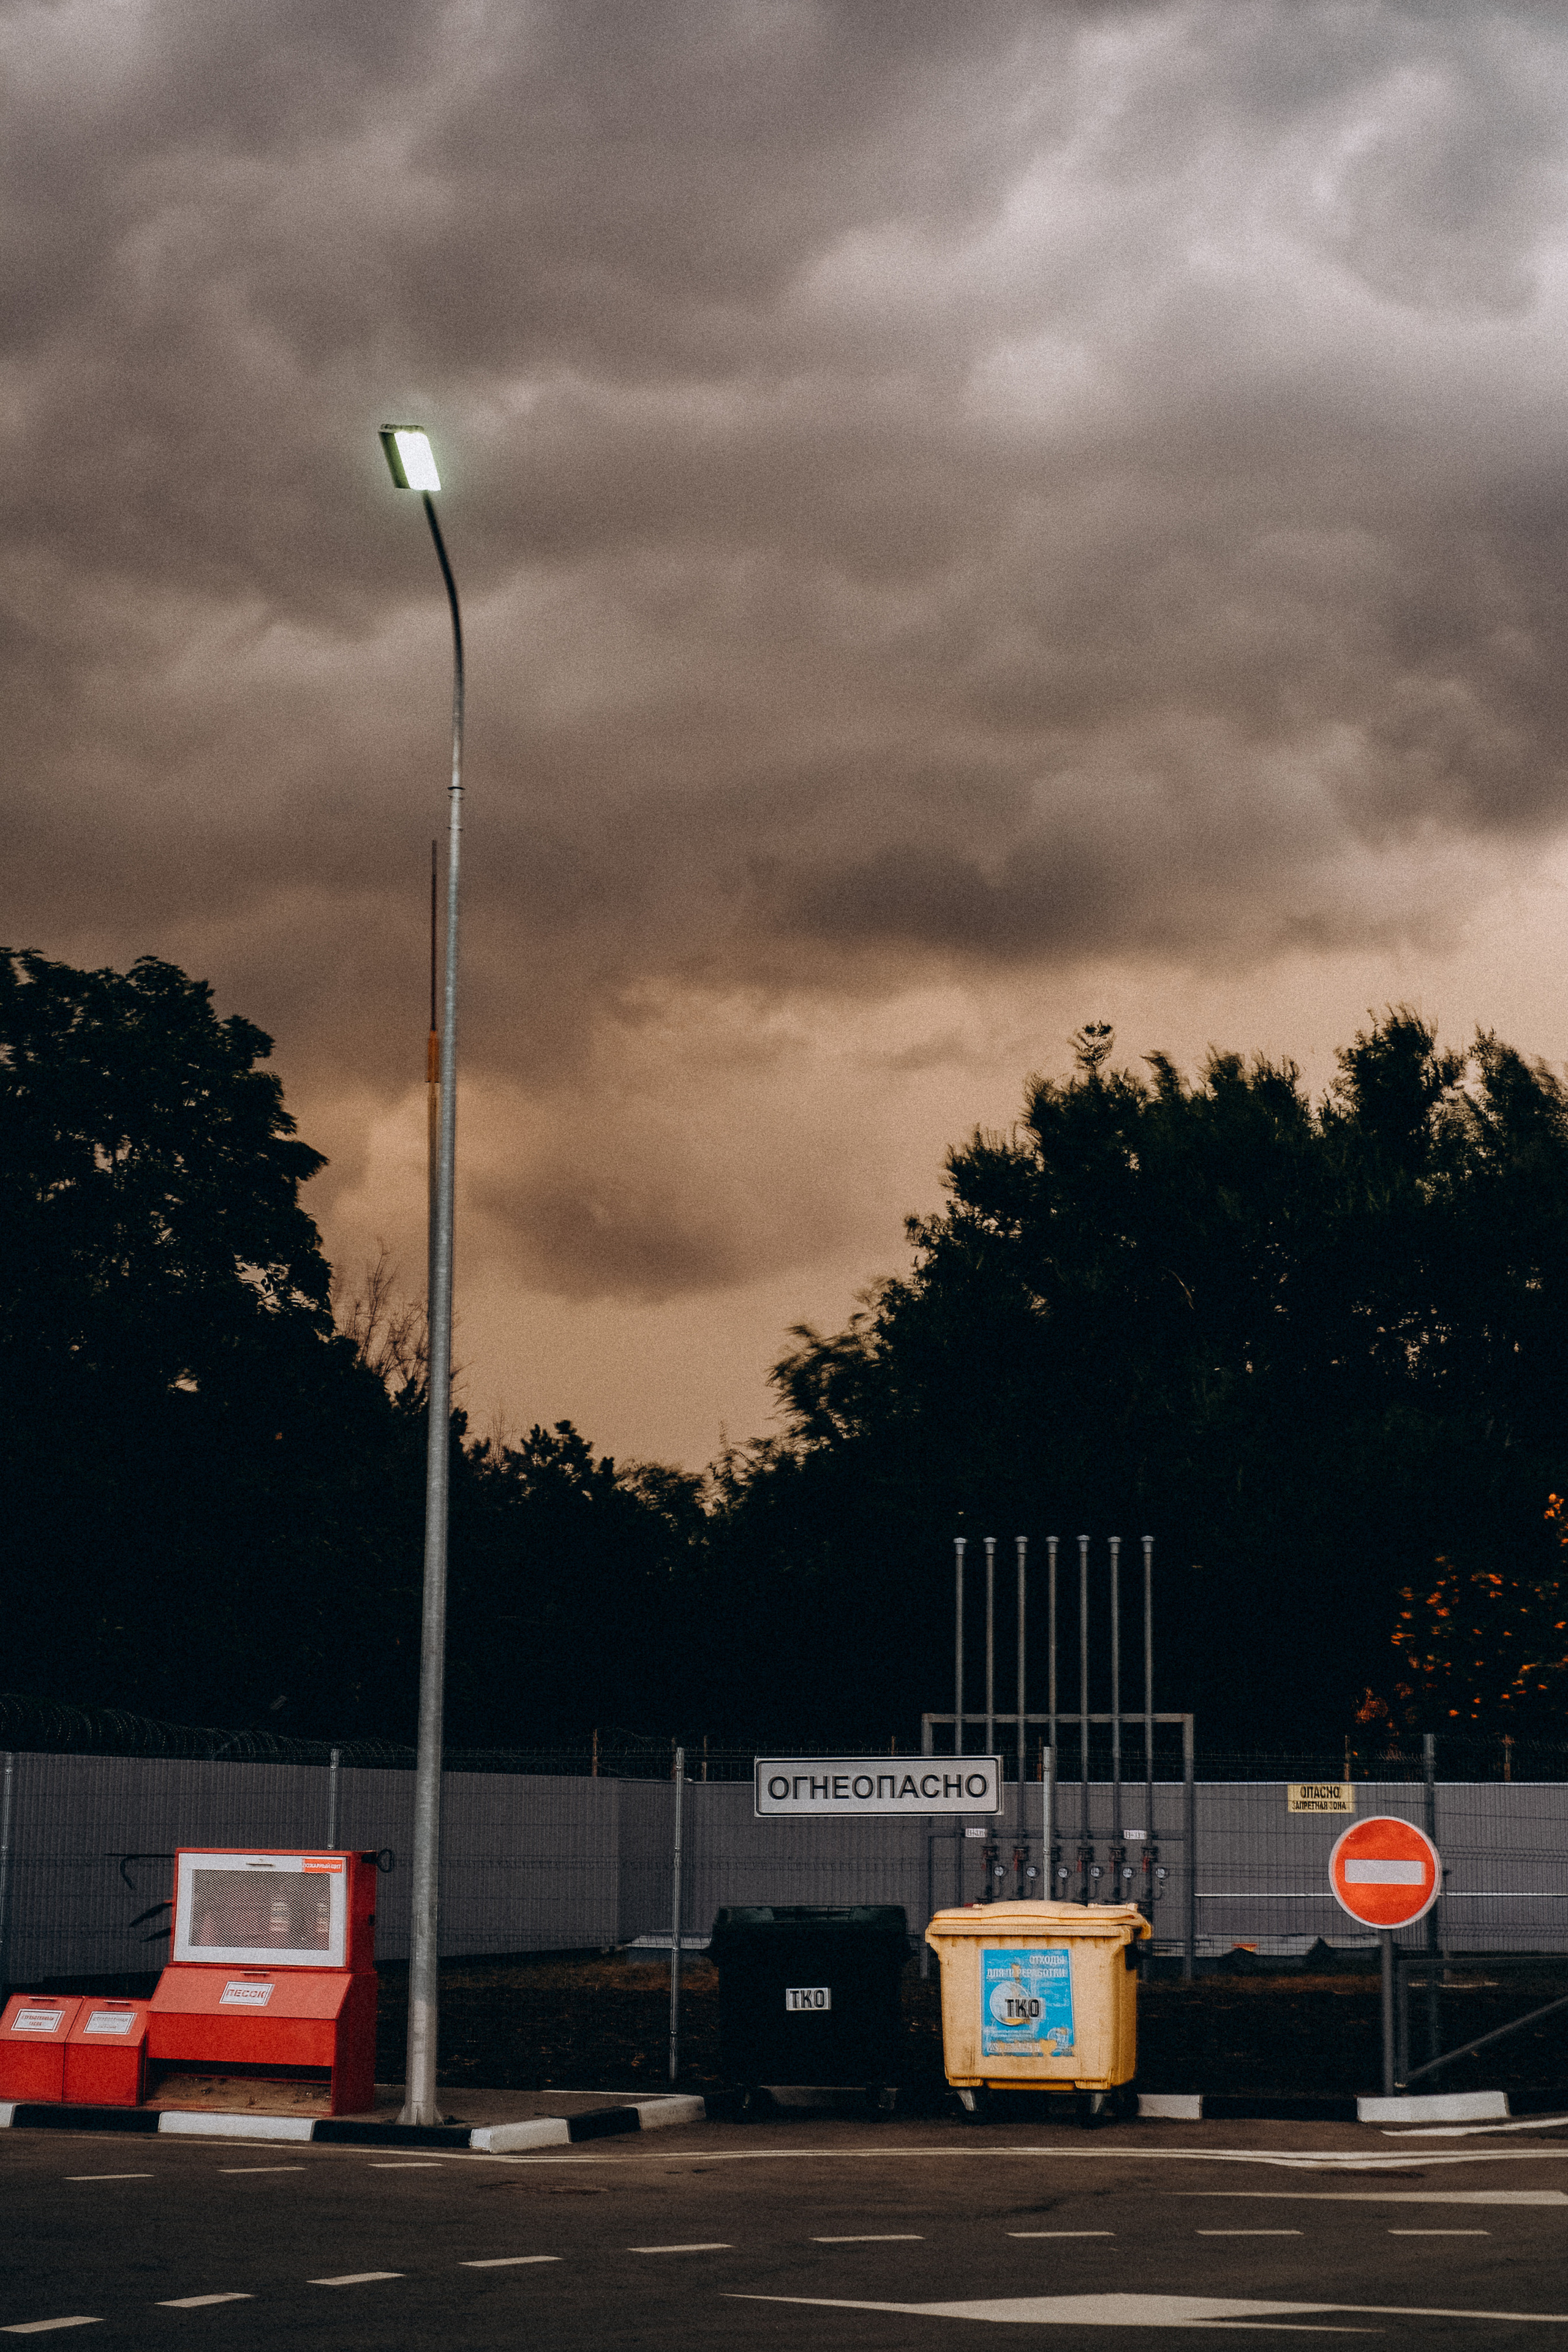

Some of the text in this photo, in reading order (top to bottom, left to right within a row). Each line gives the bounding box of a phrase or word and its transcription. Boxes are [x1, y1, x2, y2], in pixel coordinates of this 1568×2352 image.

[767, 1774, 987, 1800] ОГНЕОПАСНО
[225, 1989, 266, 1998] ПЕСОК
[790, 1989, 825, 2008] ТКО
[1005, 1999, 1039, 2018] ТКО
